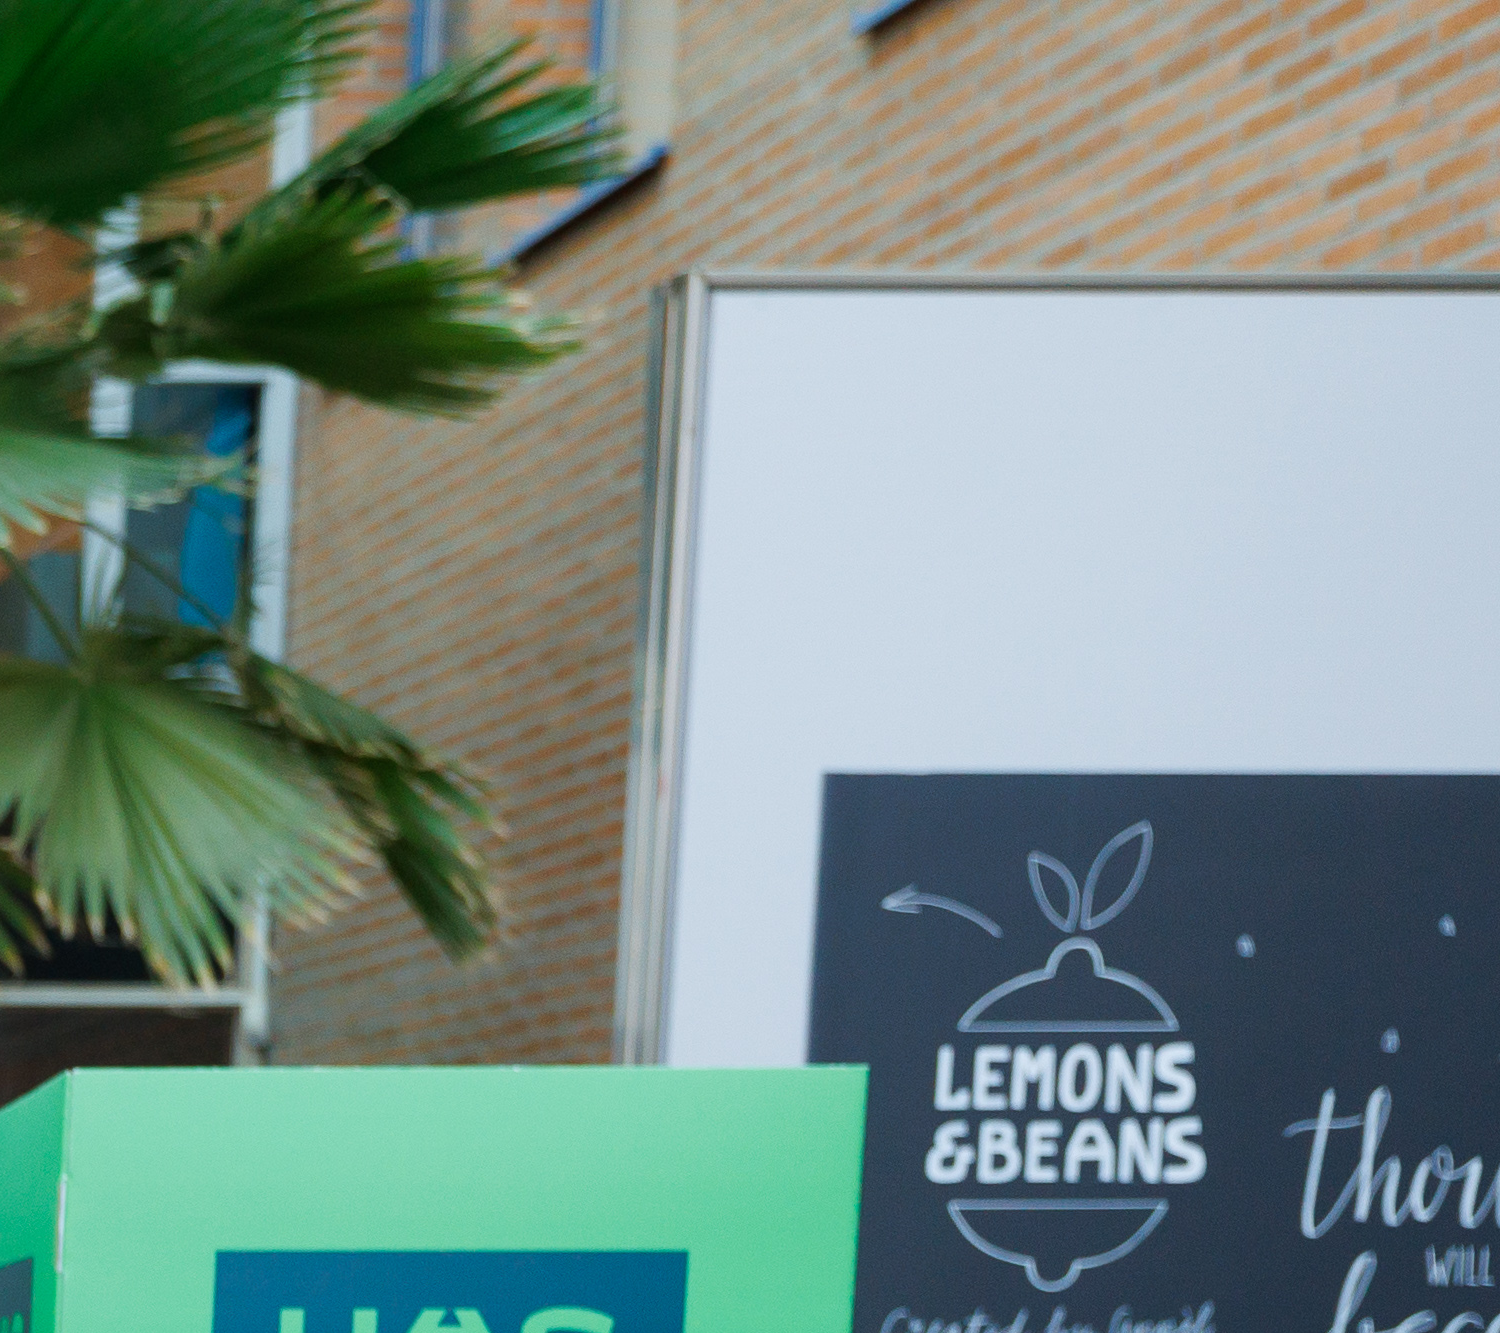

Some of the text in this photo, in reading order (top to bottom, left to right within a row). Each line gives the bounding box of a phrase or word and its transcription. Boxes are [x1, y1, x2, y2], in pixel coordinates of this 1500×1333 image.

[933, 1042, 1197, 1112] LEMONS
[925, 1115, 1207, 1185] &BEANS
[1424, 1244, 1495, 1287] WILL
